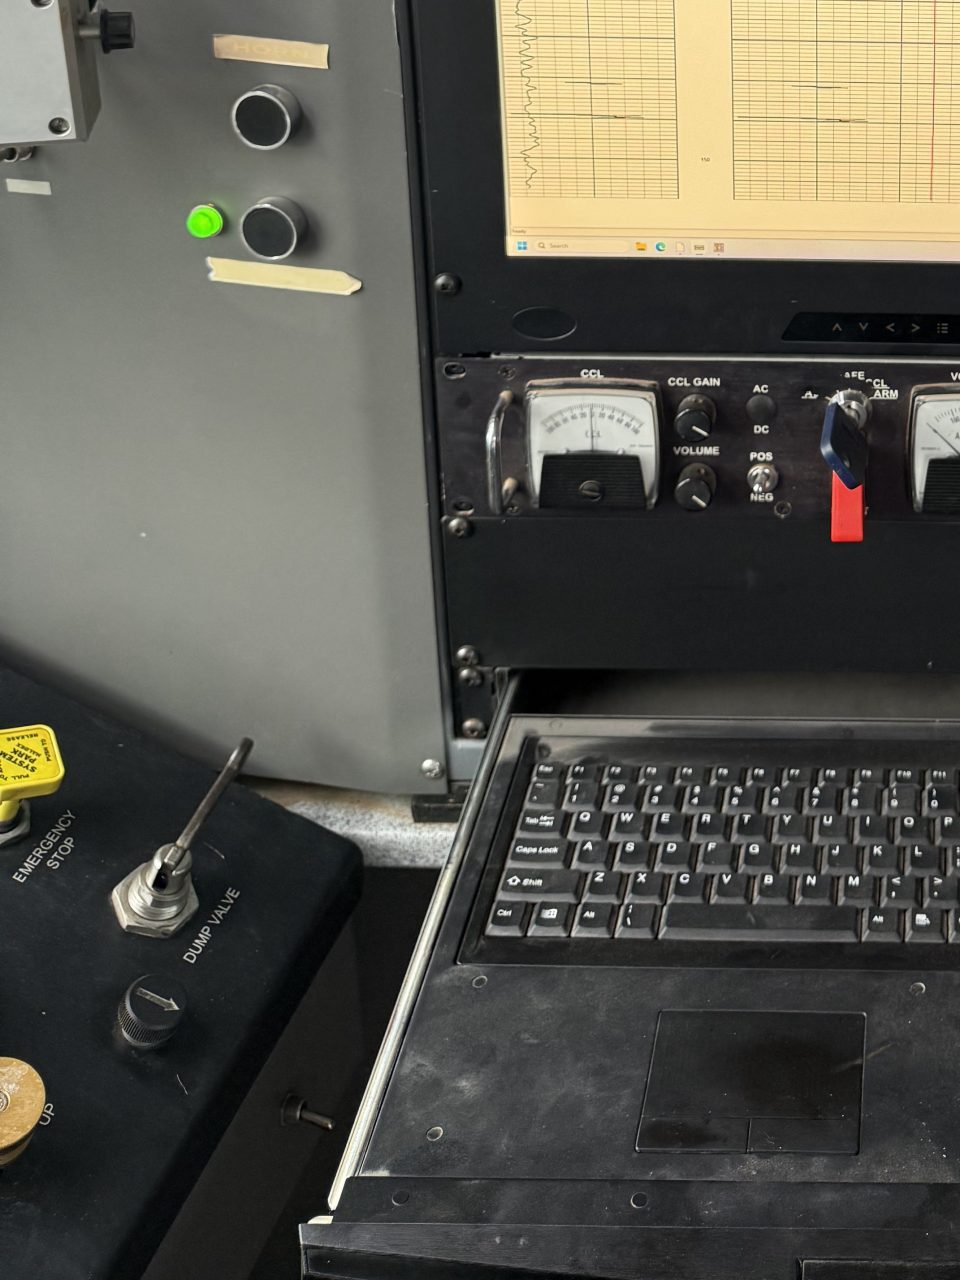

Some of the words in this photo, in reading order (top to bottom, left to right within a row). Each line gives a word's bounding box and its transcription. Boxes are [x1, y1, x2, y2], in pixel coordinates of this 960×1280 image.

[580, 369, 604, 378] CCL
[667, 377, 690, 387] CCL
[692, 377, 721, 387] GAIN
[753, 384, 769, 393] AC
[873, 389, 899, 400] ARM
[753, 425, 770, 434] DC
[673, 446, 720, 455] VOLUME
[749, 452, 773, 462] POS
[750, 492, 774, 502] NEG
[579, 811, 591, 821] Q
[620, 812, 633, 822] W
[660, 813, 670, 822] E
[701, 813, 711, 823] R
[742, 814, 751, 825] T
[12, 809, 76, 883] EMERGENCY
[538, 845, 558, 855] Lock
[582, 841, 593, 851] A
[625, 842, 635, 852] S
[46, 836, 76, 871] STOP
[182, 926, 212, 964] DUMP
[210, 887, 241, 929] VALVE
[38, 1102, 55, 1126] UP
